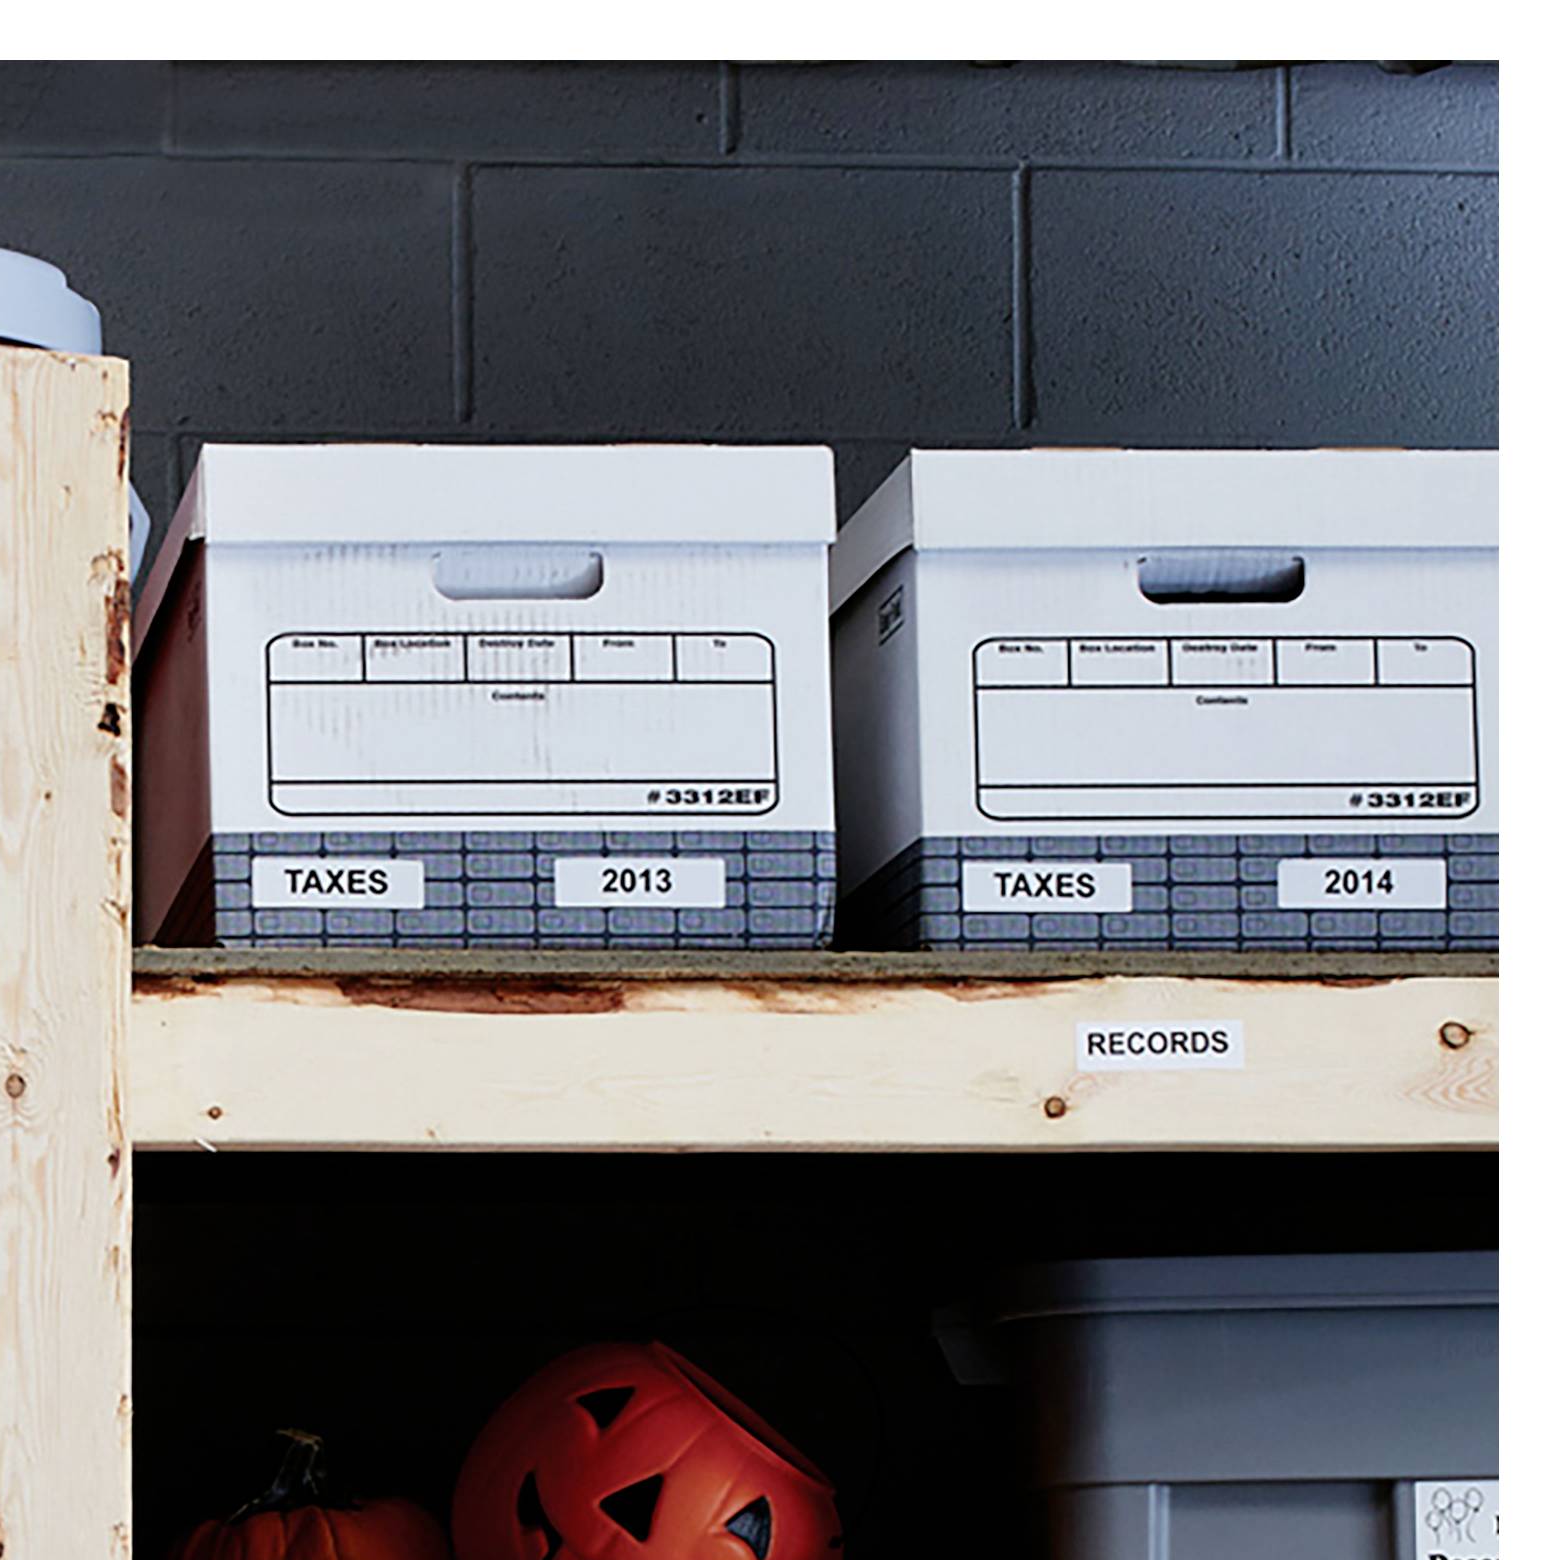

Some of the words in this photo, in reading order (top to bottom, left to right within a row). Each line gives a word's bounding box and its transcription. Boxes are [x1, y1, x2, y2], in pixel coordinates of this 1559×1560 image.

[1079, 643, 1101, 652] Box
[1104, 643, 1155, 652] Location
[284, 868, 389, 895] TAXES
[602, 868, 672, 894] 2013
[993, 872, 1096, 899] TAXES
[1325, 869, 1394, 895] 2014
[1088, 1030, 1229, 1055] RECORDS
